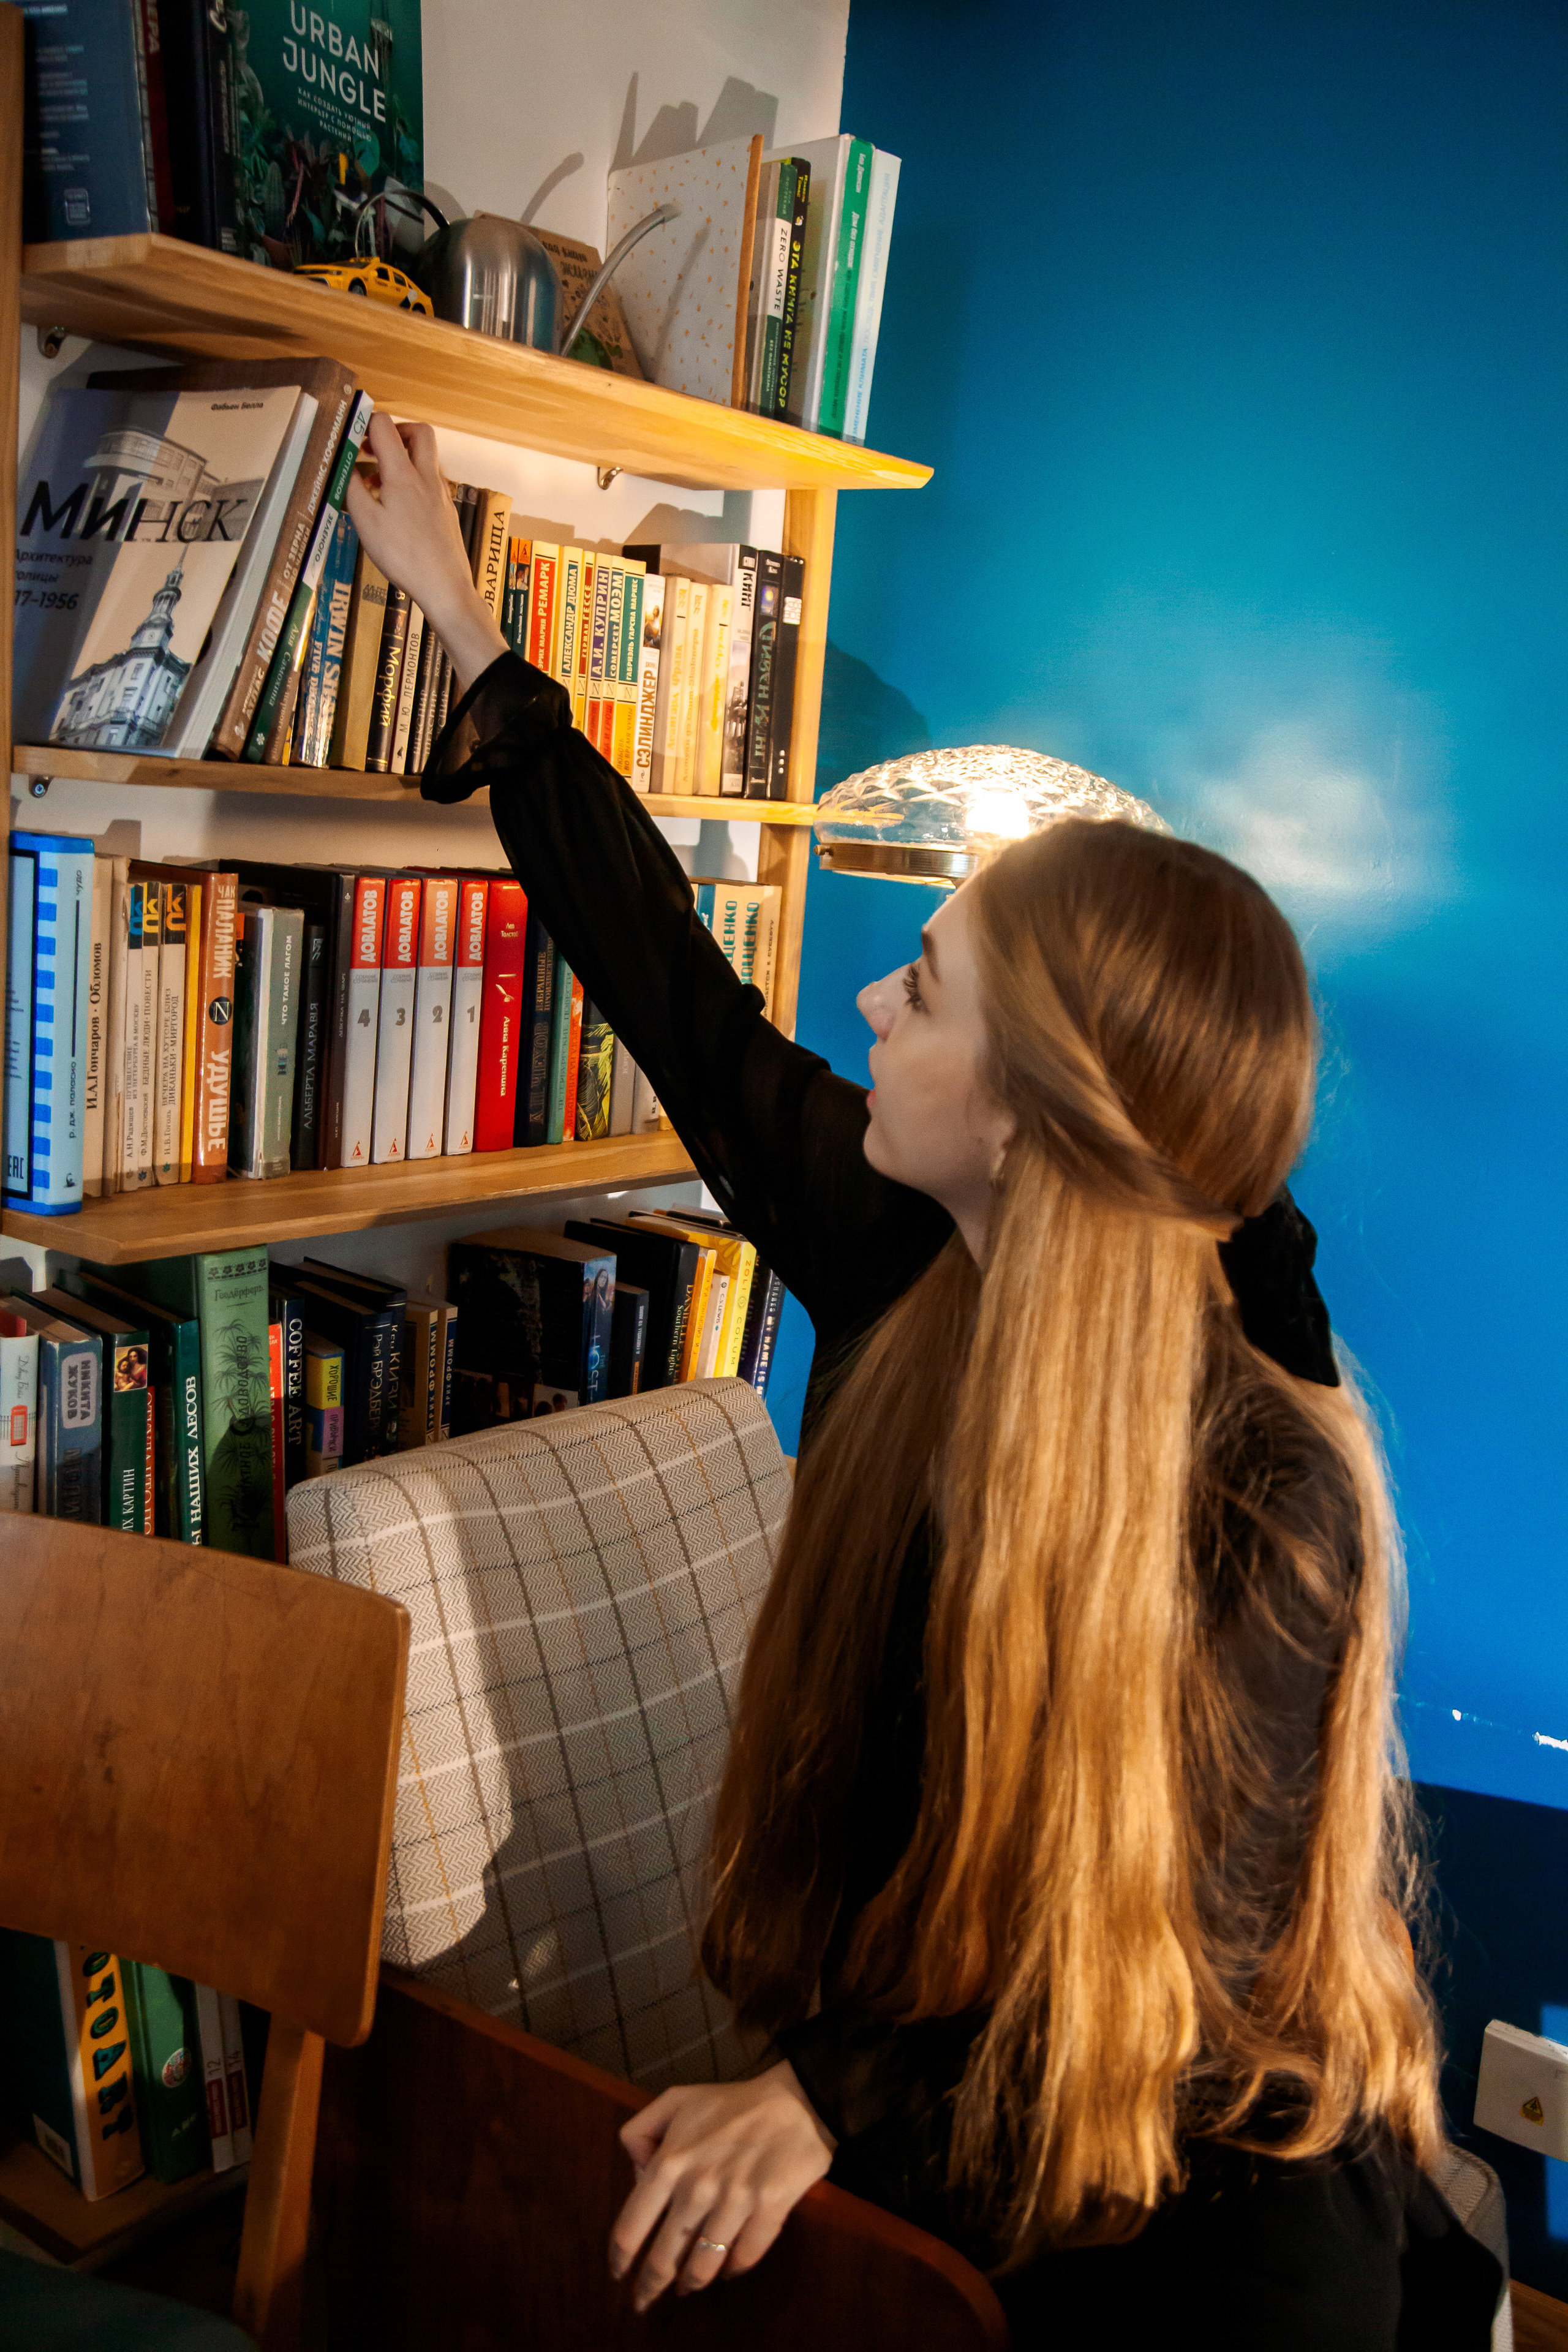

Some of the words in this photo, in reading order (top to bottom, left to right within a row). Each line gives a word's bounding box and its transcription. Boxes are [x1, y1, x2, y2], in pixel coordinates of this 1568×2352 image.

[291, 0, 379, 80] URBAN
[283, 36, 386, 123] JUNGLE
[298, 97, 329, 121] ИНТЕРЬЕР
[337, 117, 372, 142] ПОМОЩЬЮ
[313, 92, 342, 116] СОЗДАТЬ
[344, 111, 371, 130] УЮТНЫЙ
[320, 119, 352, 142] РАСТЕНИЙ
[778, 227, 788, 263] ZERO
[790, 240, 801, 269] ЭТА
[774, 268, 785, 311] WASTE
[786, 273, 797, 324] КНИГА
[784, 329, 793, 350] НЕ
[778, 353, 790, 408] МУСОР
[211, 402, 240, 411] Фабьен
[353, 411, 368, 435] 45
[307, 464, 327, 516] ДЖЕЙМС
[322, 399, 347, 466] ХОФФМАНН
[334, 451, 353, 501] ОТТЕНКОВ
[284, 562, 292, 579] ОТ
[288, 523, 306, 560] ЗЕРНА
[315, 513, 333, 562] ЗЕЛЕНОГО
[484, 511, 505, 614] ВАРИЩА
[538, 561, 550, 617] РЕМАРК
[568, 568, 578, 606] ДЮМА
[582, 584, 592, 620] ГЕССЕ
[595, 570, 609, 637] КУПРИН
[609, 573, 624, 624] МОЭМ
[741, 572, 753, 611] КИНГ
[256, 590, 284, 665] КОФЕ
[288, 623, 300, 647] Аля
[326, 579, 352, 660] IRWIN
[563, 606, 576, 671] АЛЕКСАНДР
[404, 633, 420, 699] ЛЕРМОНТОВ
[610, 624, 620, 677] СОМЕРСЕТ
[625, 641, 634, 681] ГАБРИЭЛЬ
[269, 651, 291, 707] Самохина
[377, 645, 401, 727] Морфий
[636, 669, 657, 768] СЭЛИНДЖЕР
[624, 760, 630, 771] ВО
[217, 885, 236, 899] ЧАК
[213, 899, 235, 979] ПАЛАНИК
[360, 889, 378, 962] ДОВЛАТОВ
[398, 891, 414, 962] ДОВЛАТОВ
[434, 890, 448, 961] ДОВЛАТОВ
[469, 892, 484, 961] ДОВЛАТОВ
[723, 900, 737, 965] ЩЕНКО
[89, 943, 102, 1005] Обломов
[282, 971, 291, 1002] ТАКОЕ
[341, 992, 345, 1004] НА
[536, 951, 546, 1011] ИЗБРАННЫЕ
[170, 995, 179, 1047] МИРГОРОД
[357, 1009, 371, 1027] 4
[395, 1008, 405, 1026] 3
[432, 1005, 443, 1023] 2
[467, 1005, 475, 1023] 1
[164, 1055, 170, 1069] НА
[500, 1047, 510, 1097] Каренина
[531, 1020, 549, 1086] ЧЕХОВ
[558, 1027, 568, 1110] ПЕТЕРБУРГСКИЕ
[168, 1052, 176, 1106] ДИКАНЬКИ
[208, 1049, 230, 1153] УДУШЬЕ
[304, 1067, 315, 1129] АЛЬБЕРТА
[741, 1259, 752, 1291] ZOLI
[673, 1305, 684, 1346] Southern
[731, 1316, 742, 1365] COLUM
[288, 1317, 303, 1399] COFFEE
[429, 1330, 437, 1392] ФРОММ
[446, 1338, 454, 1381] ФРОММ
[668, 1349, 678, 1376] Lights
[757, 1371, 766, 1382] IS
[761, 1336, 771, 1368] NAME
[67, 1364, 78, 1420] ЖУКОВ
[80, 1359, 91, 1420] НИКИТА
[326, 1364, 339, 1402] ХОРОШИЕ
[368, 1360, 383, 1435] БРЭДБЕРИ
[388, 1351, 401, 1409] КИЗИ
[186, 1375, 198, 1439] ЛЕСОВ
[288, 1404, 303, 1445] ART
[328, 1414, 339, 1452] ПРИВЫЧКИ
[123, 1468, 135, 1515] КАРТИН
[188, 1445, 202, 1524] НАШИХ
[207, 2058, 222, 2075] 12
[227, 2049, 241, 2067] 14
